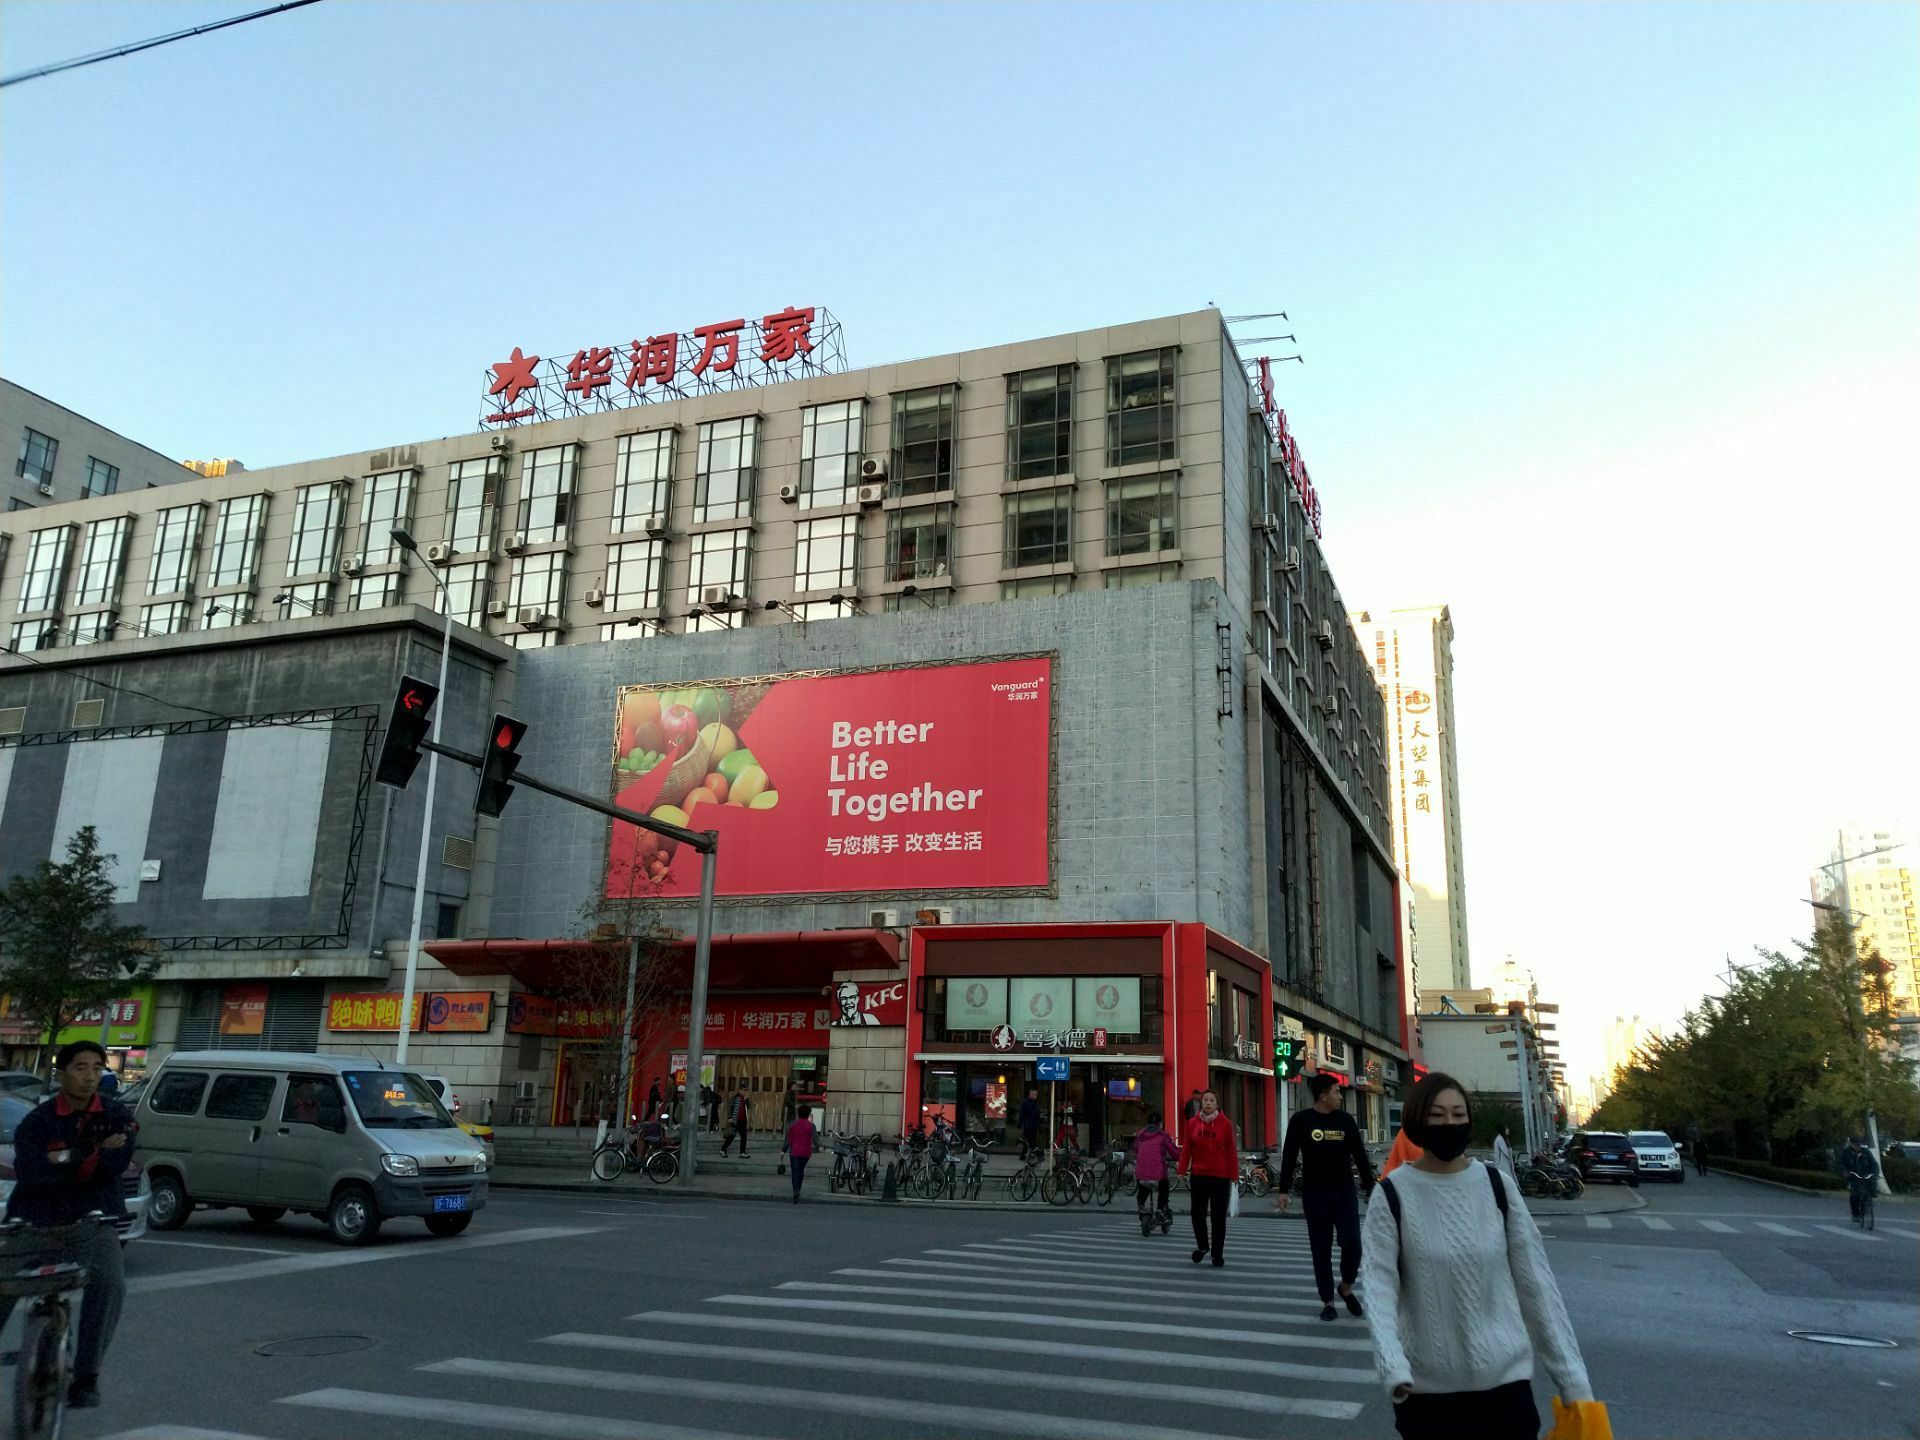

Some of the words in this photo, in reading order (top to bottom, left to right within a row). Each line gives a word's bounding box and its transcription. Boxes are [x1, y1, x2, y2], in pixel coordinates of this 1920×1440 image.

[565, 306, 815, 399] 华润万家
[991, 680, 1038, 692] Vanguard
[1008, 691, 1038, 701] 华润万家
[832, 719, 934, 749] Better
[830, 751, 889, 782] Life
[827, 782, 983, 822] Together
[825, 834, 899, 856] 与您携手
[905, 831, 983, 852] 改变生活
[864, 983, 903, 1011] KFC
[742, 1011, 807, 1030] 华润万家
[1023, 1028, 1087, 1048] 喜家德
[1275, 1041, 1291, 1056] 20
